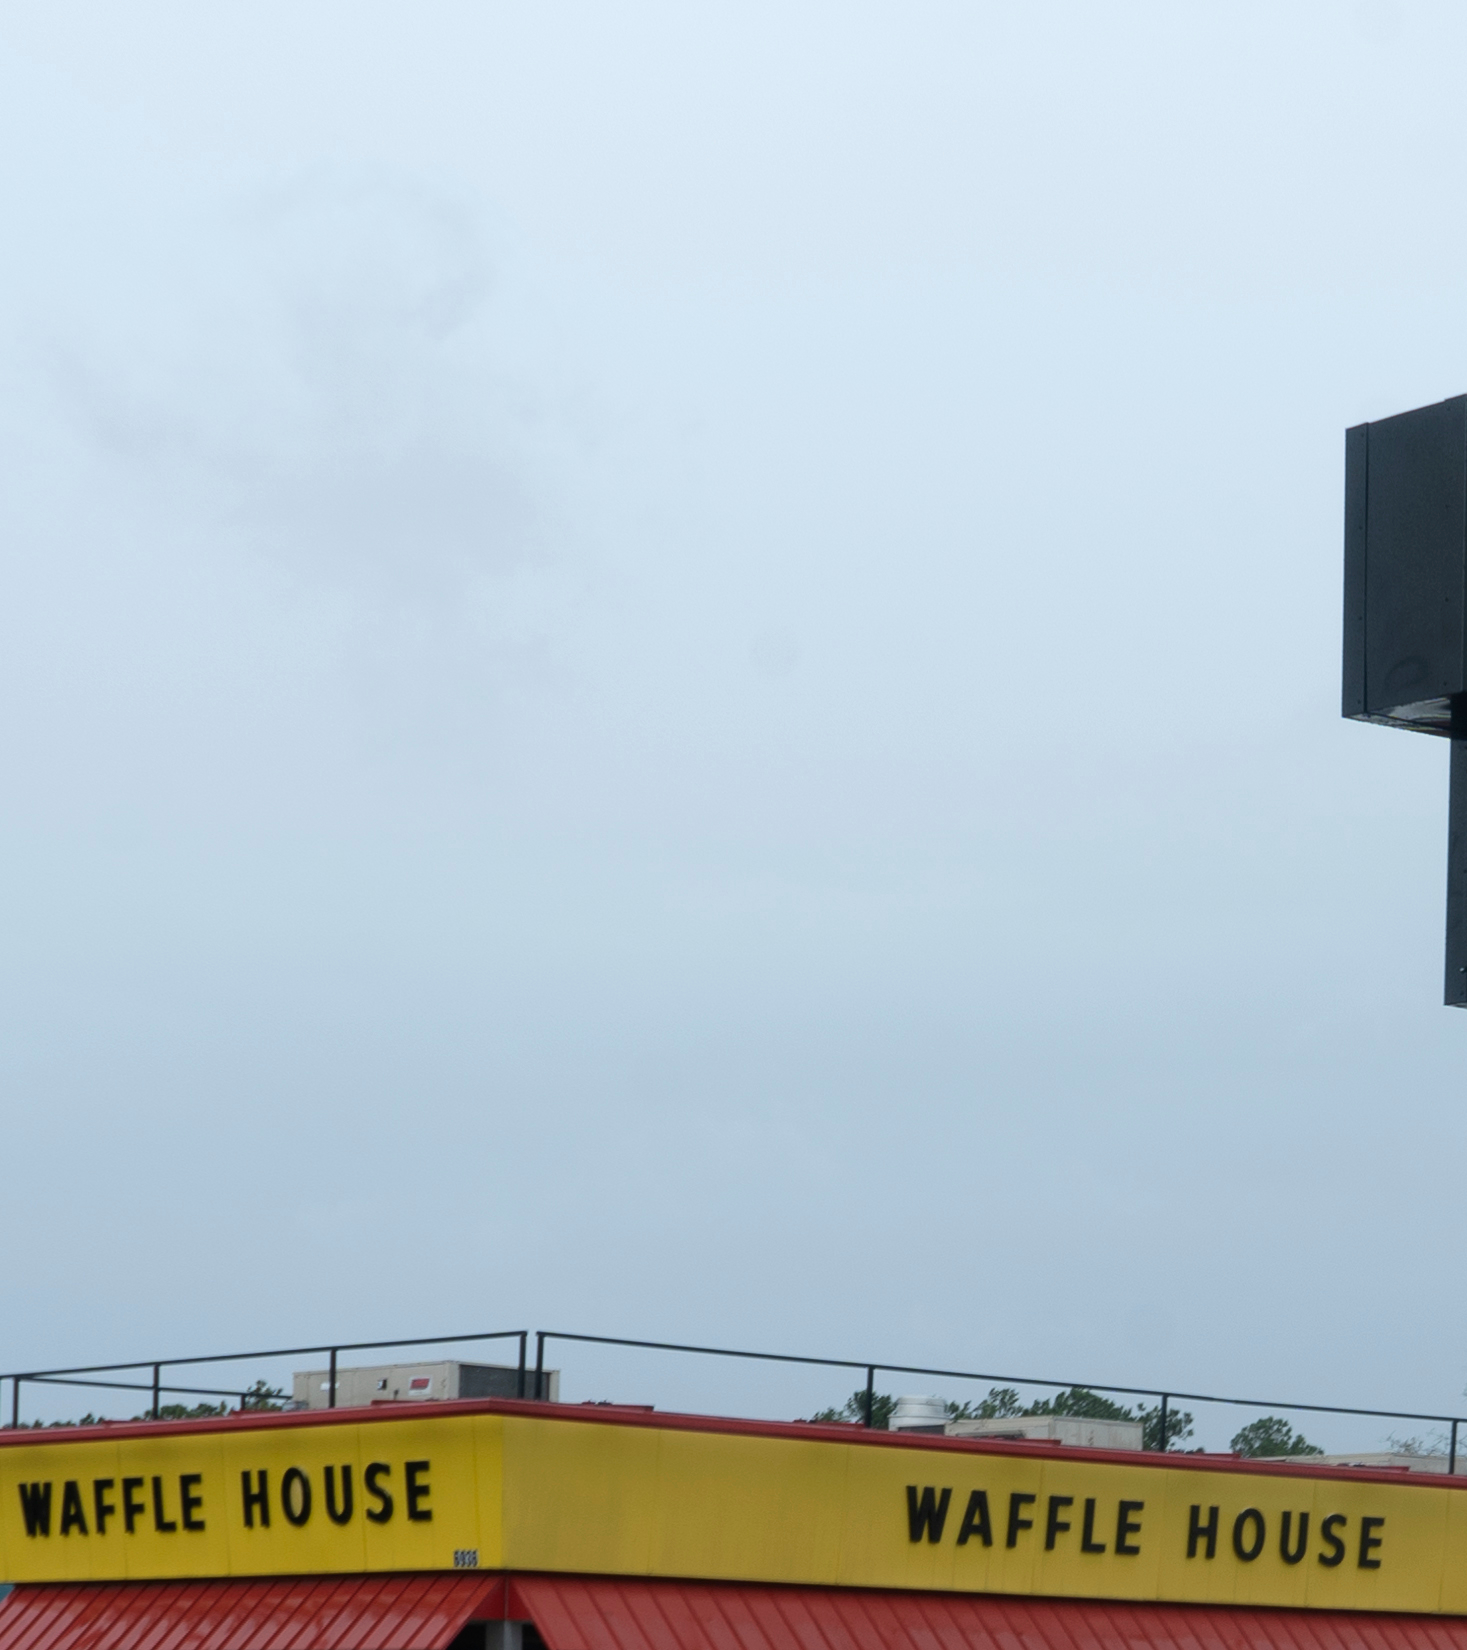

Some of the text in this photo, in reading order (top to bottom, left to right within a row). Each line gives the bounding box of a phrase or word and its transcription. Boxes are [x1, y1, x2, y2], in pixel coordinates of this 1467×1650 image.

[18, 1460, 433, 1537] WAFFLE HOUSE
[906, 1485, 1386, 1569] WAFFLE HOUSE
